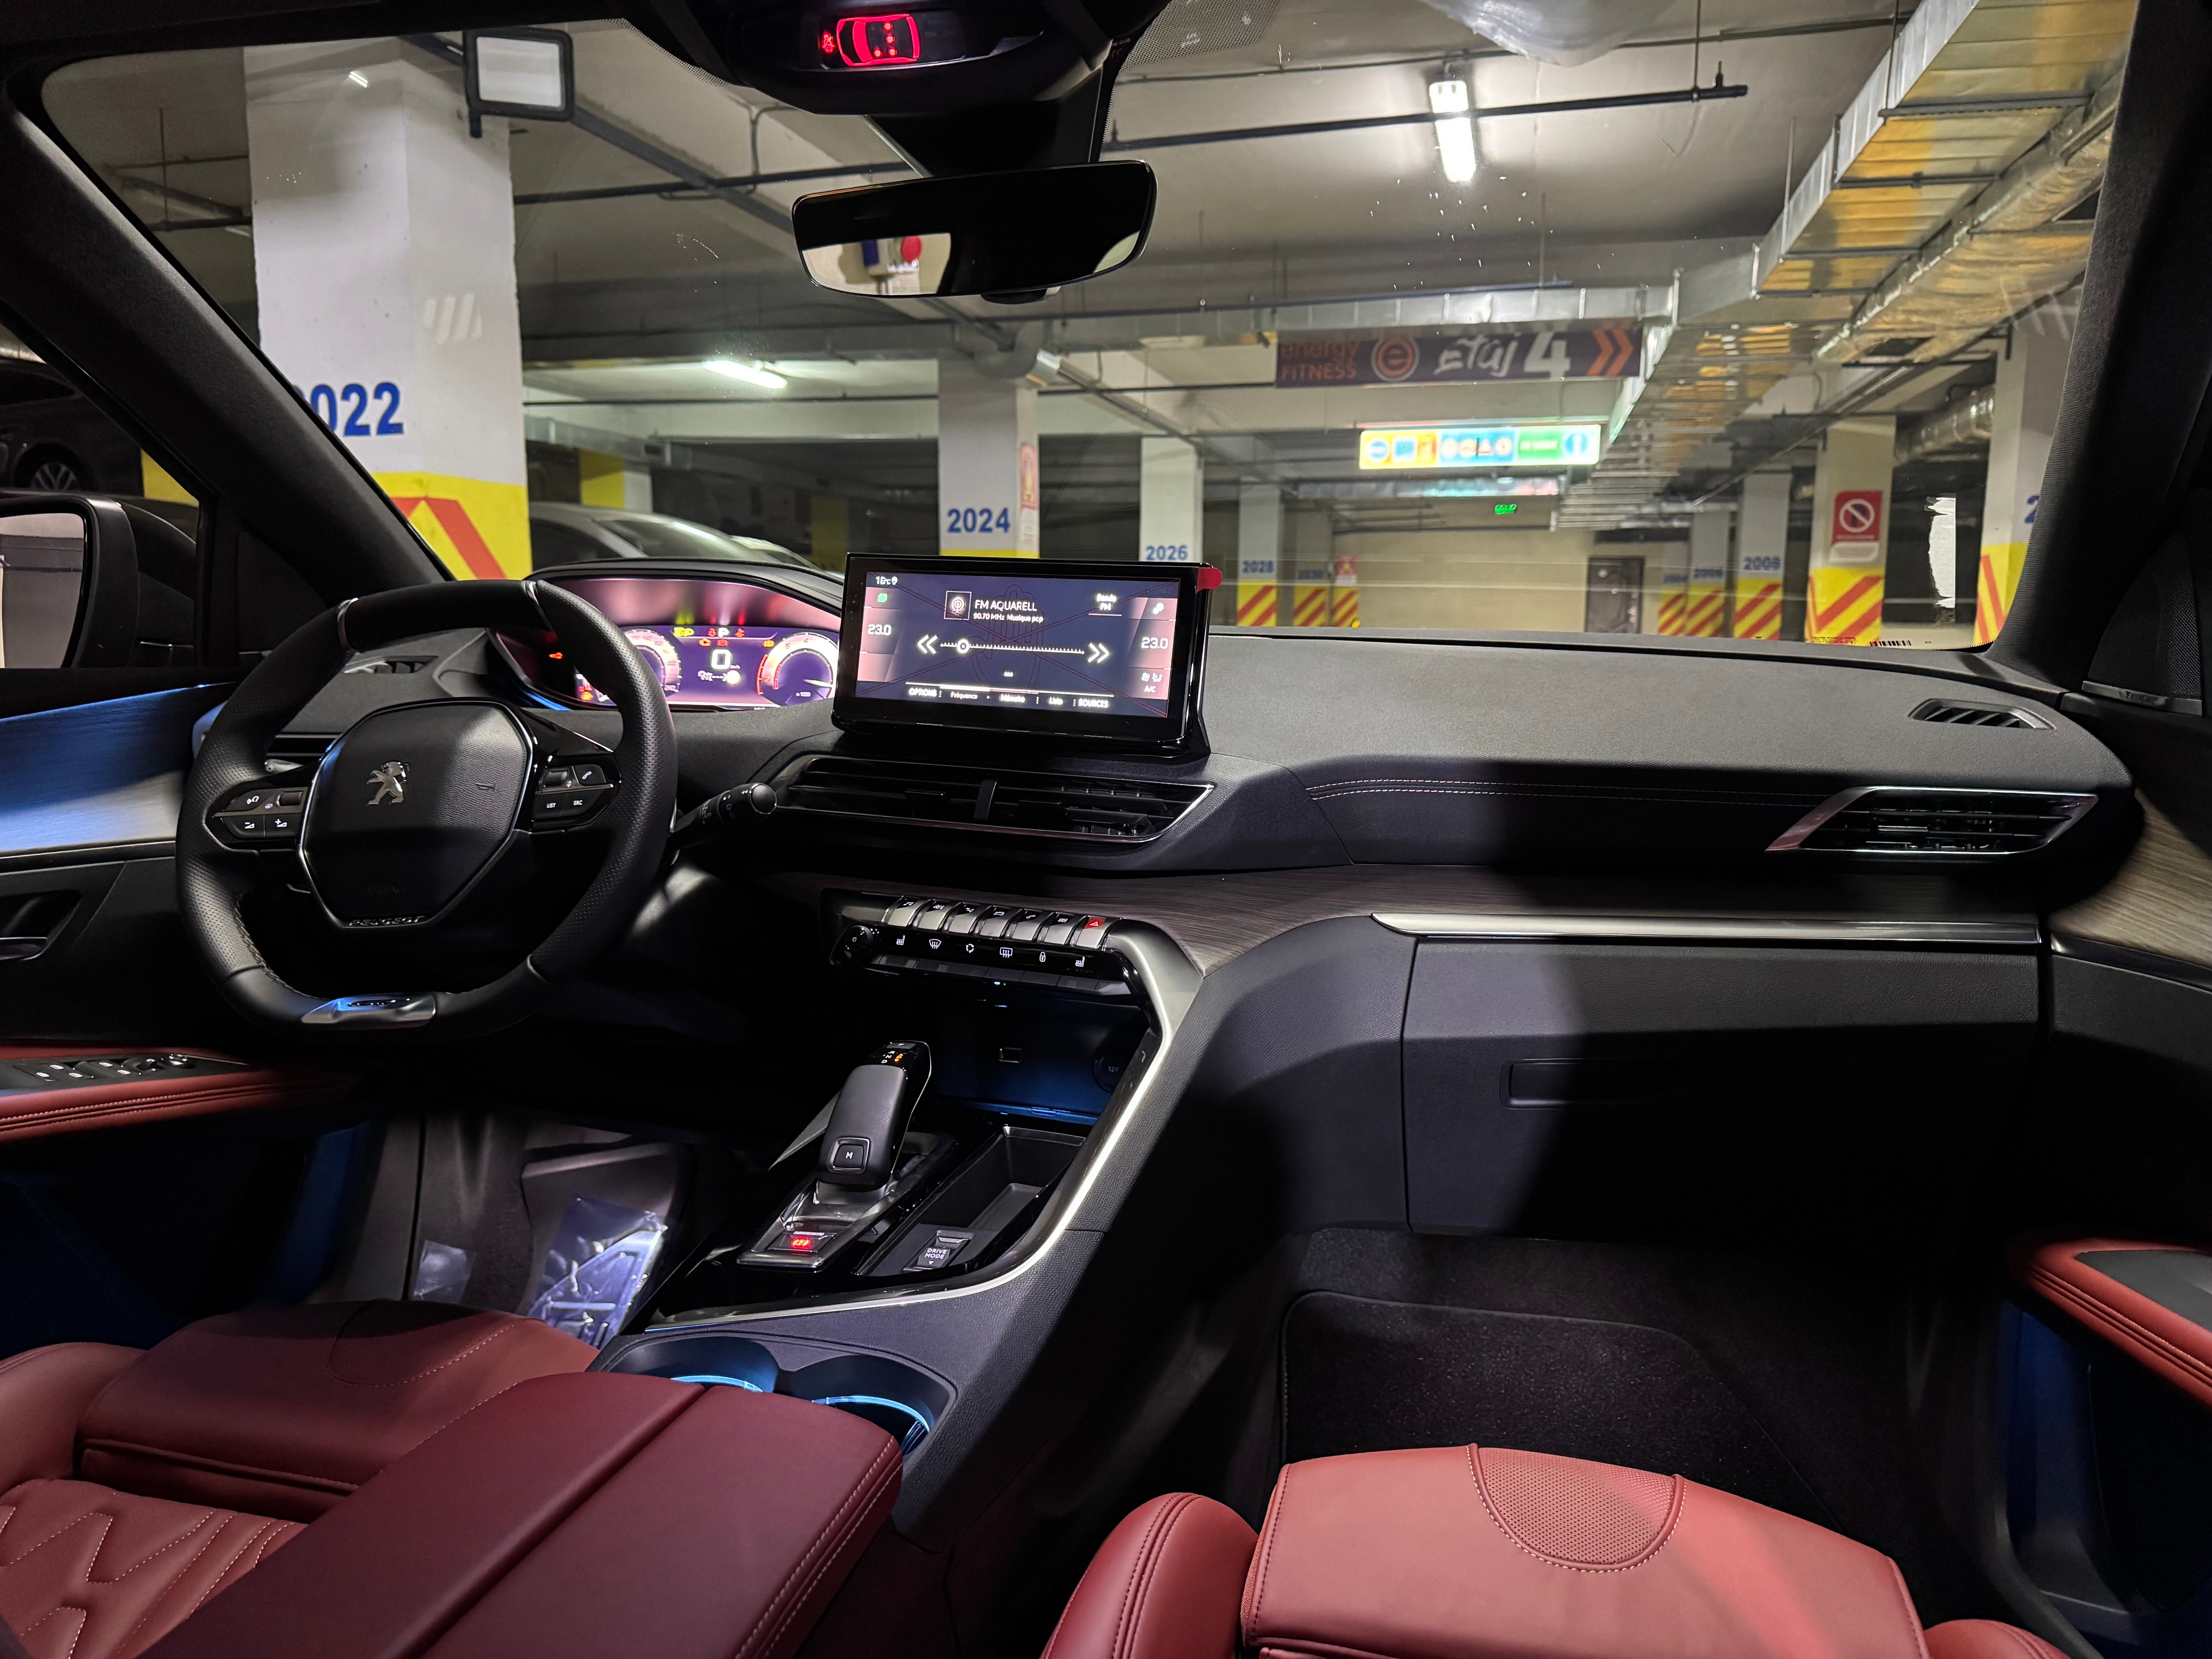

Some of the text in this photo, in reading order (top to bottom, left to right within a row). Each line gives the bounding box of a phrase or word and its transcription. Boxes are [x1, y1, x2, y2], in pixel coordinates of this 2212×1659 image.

[1524, 330, 1571, 380] 4
[292, 382, 404, 436] 022
[947, 507, 1011, 533] 2024
[1146, 545, 1188, 560] 2026
[974, 599, 1037, 611] FM AQUARELL
[1006, 614, 1031, 623] Musique
[867, 623, 891, 635] 23.0
[1141, 637, 1168, 649] 23.0
[711, 649, 731, 669] 0
[908, 687, 937, 697] OPTIONS
[1078, 698, 1109, 709] SOURCES
